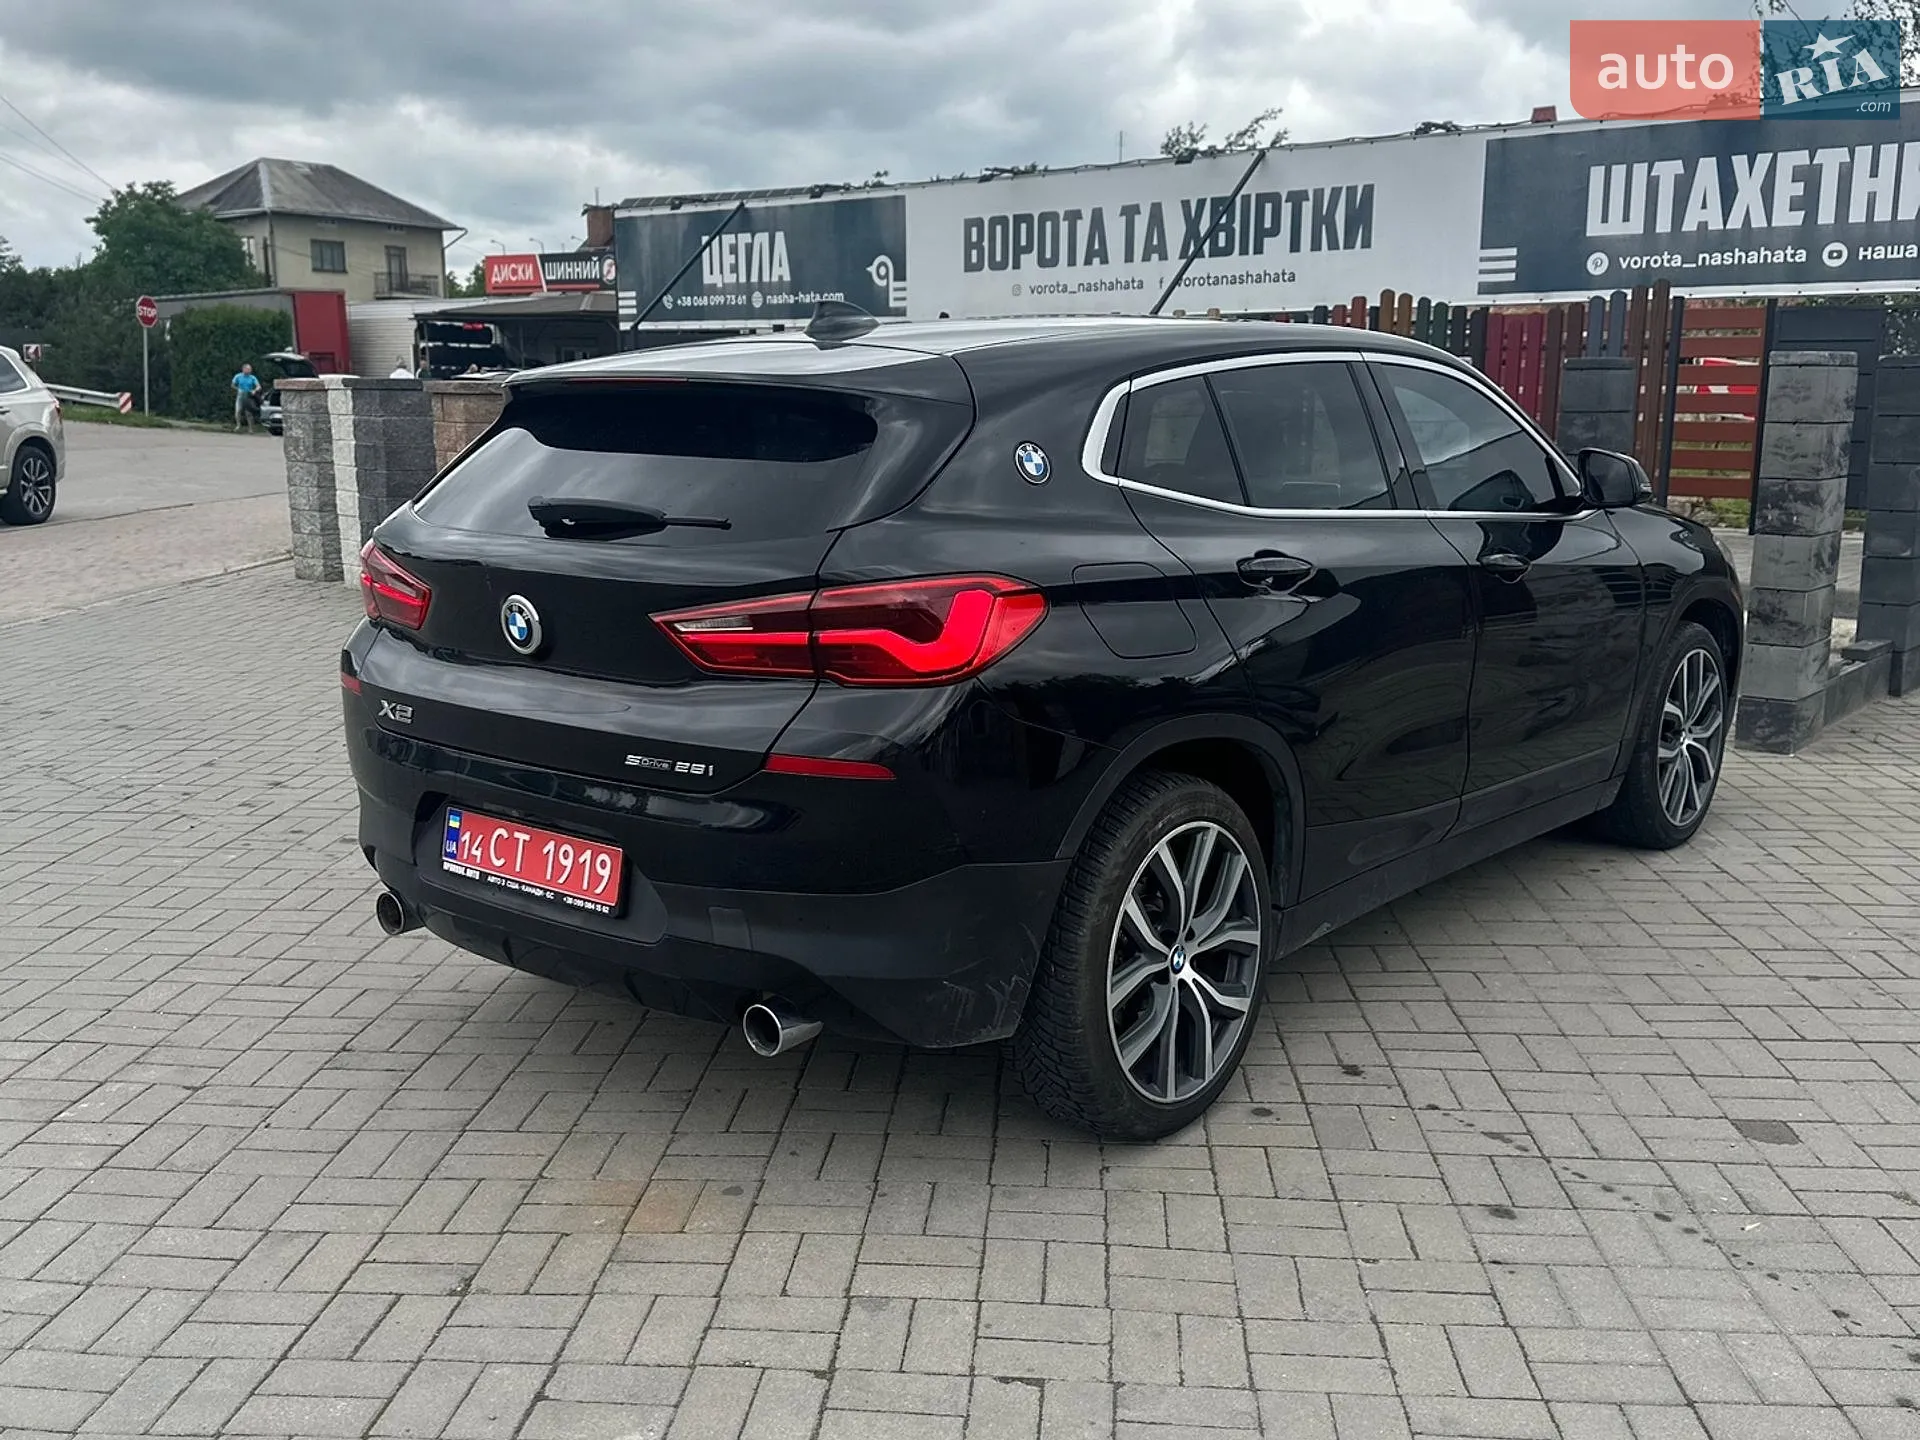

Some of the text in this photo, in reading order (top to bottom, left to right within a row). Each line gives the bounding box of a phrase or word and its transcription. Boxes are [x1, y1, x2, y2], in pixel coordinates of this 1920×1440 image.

[963, 183, 1376, 273] ВОРОТА ТА ХВІРТКИ
[701, 231, 791, 287] ЦЕГЛА
[1618, 244, 1807, 269] vorota_nashahata
[1858, 243, 1919, 261] наша
[491, 263, 534, 284] ДИСКИ
[544, 256, 600, 280] ШИННИЙ
[766, 290, 844, 304] nasha-hata.com
[1029, 277, 1144, 297] vorota_nashahata
[138, 306, 157, 317] STOP
[378, 700, 413, 723] X2
[445, 840, 456, 854] UA
[542, 839, 612, 895] 1919
